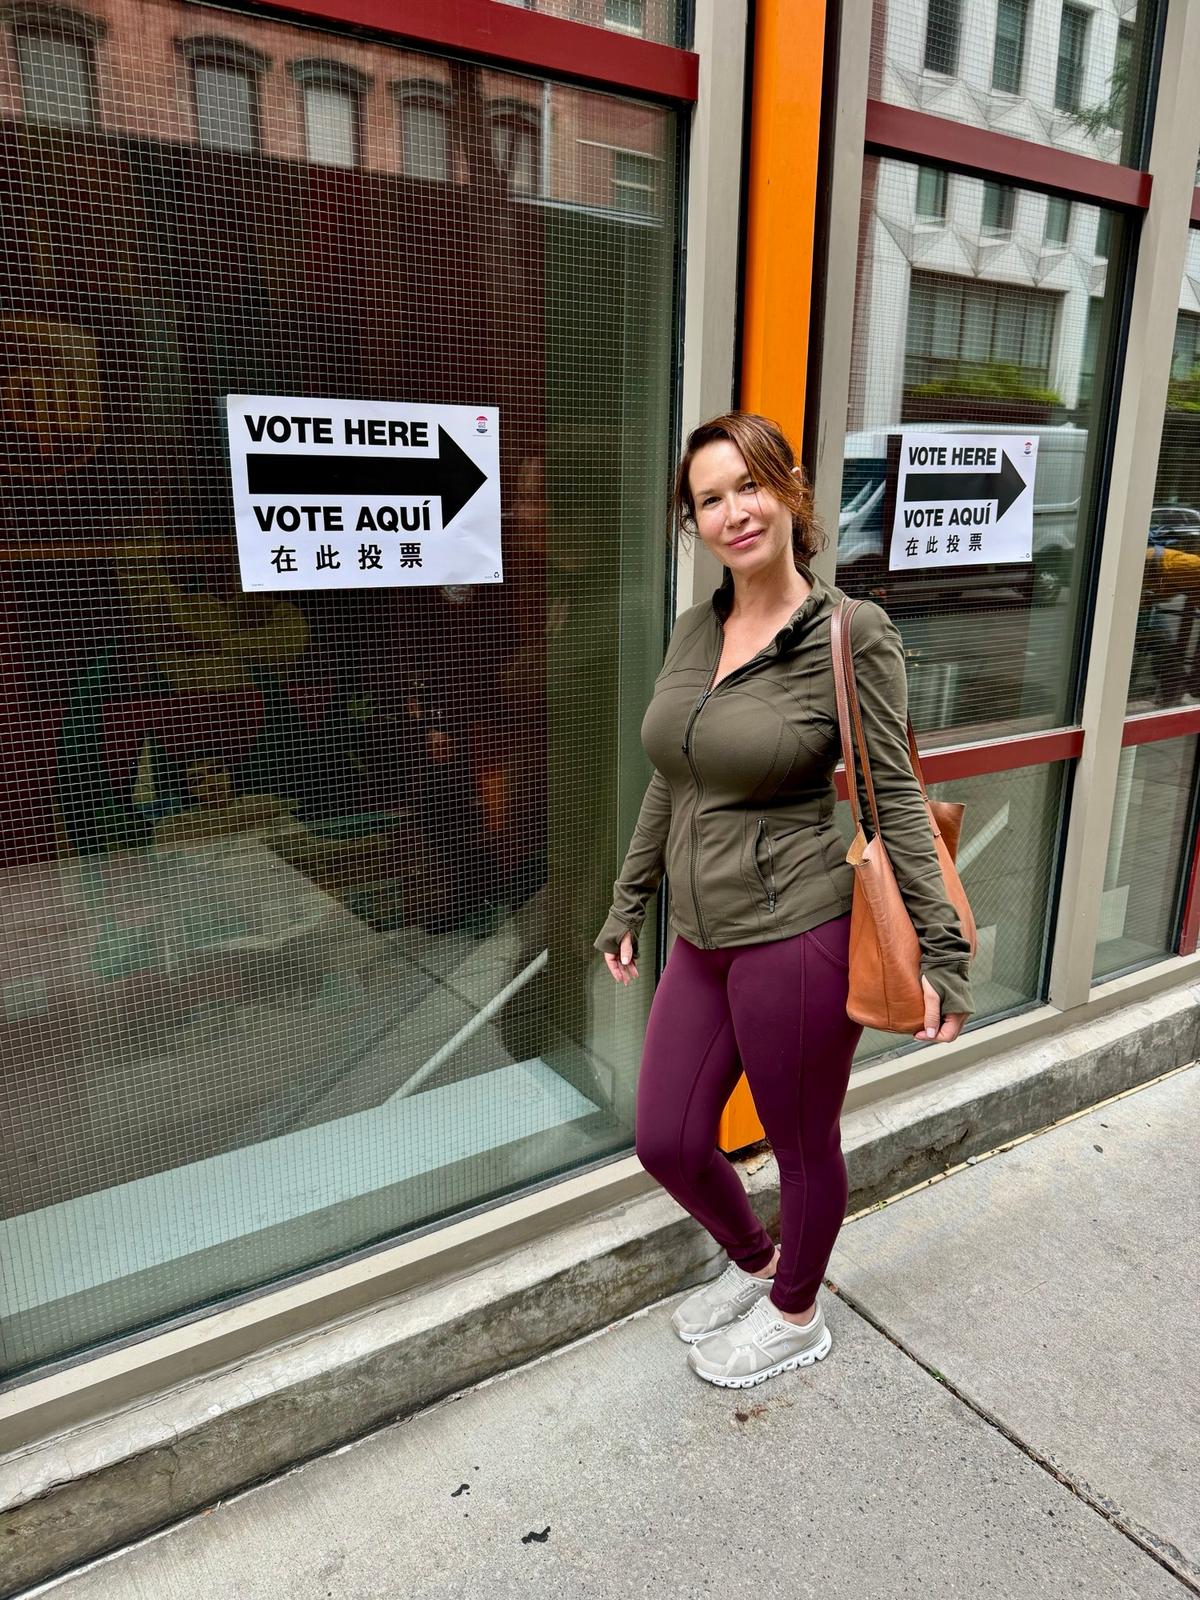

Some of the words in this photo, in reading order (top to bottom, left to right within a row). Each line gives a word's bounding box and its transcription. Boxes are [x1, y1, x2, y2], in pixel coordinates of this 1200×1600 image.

[244, 415, 333, 444] VOTE
[345, 419, 428, 447] HERE
[908, 447, 947, 466] VOTE
[951, 448, 997, 466] HERE
[253, 506, 343, 532] VOTE
[355, 500, 431, 533] AQUÍ
[904, 509, 944, 528] VOTE
[948, 503, 991, 526] AQUÍ
[270, 542, 423, 574] 在此投票
[905, 533, 982, 557] 在此投票
